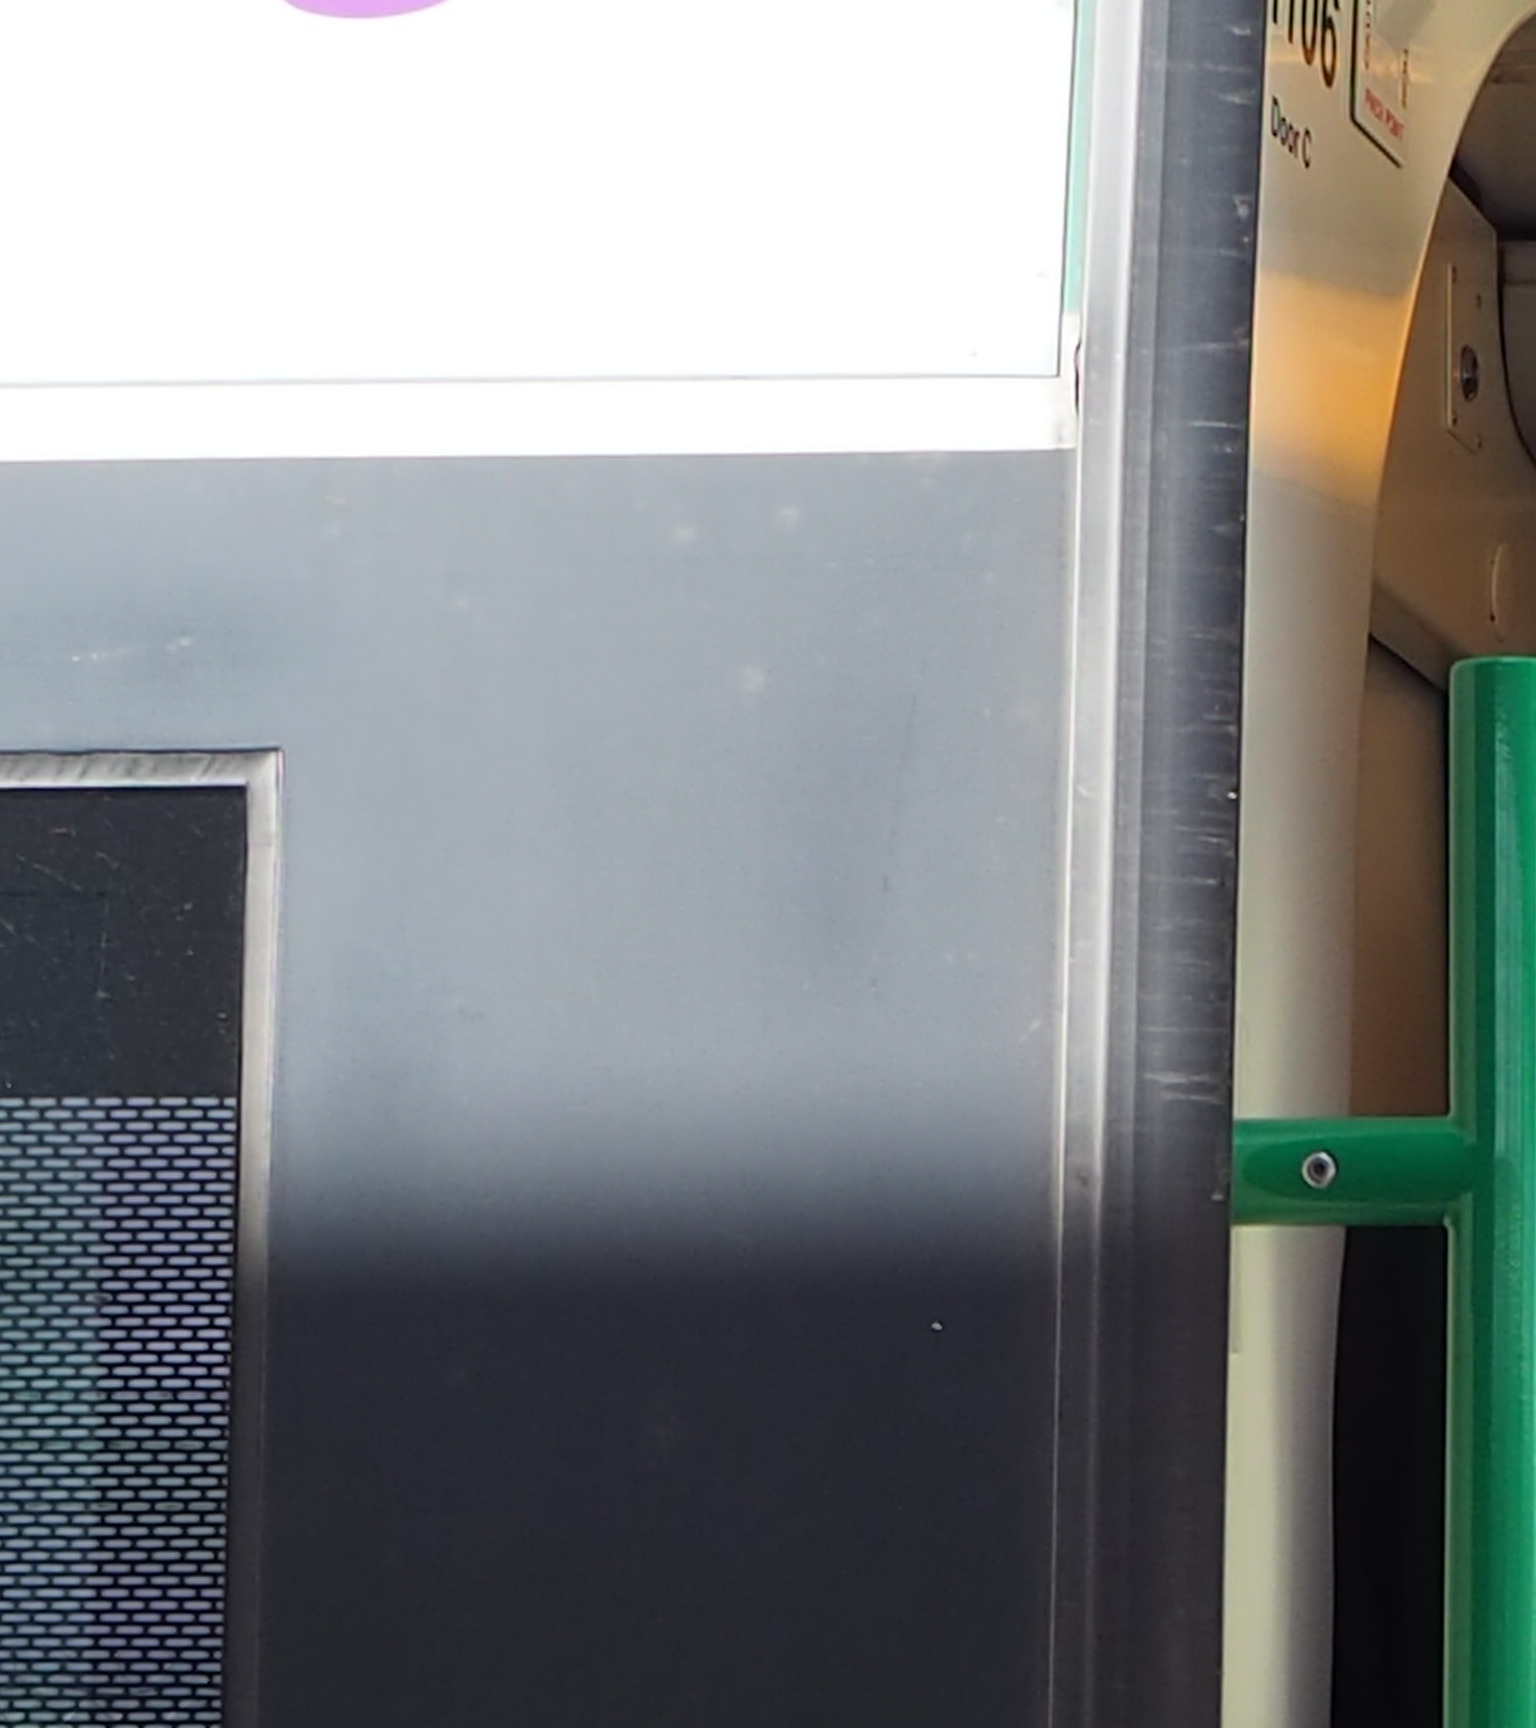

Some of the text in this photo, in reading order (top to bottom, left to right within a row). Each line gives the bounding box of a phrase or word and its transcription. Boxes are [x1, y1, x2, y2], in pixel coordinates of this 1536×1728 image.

[1272, 0, 1340, 88] 06
[1271, 95, 1312, 169] Door C
